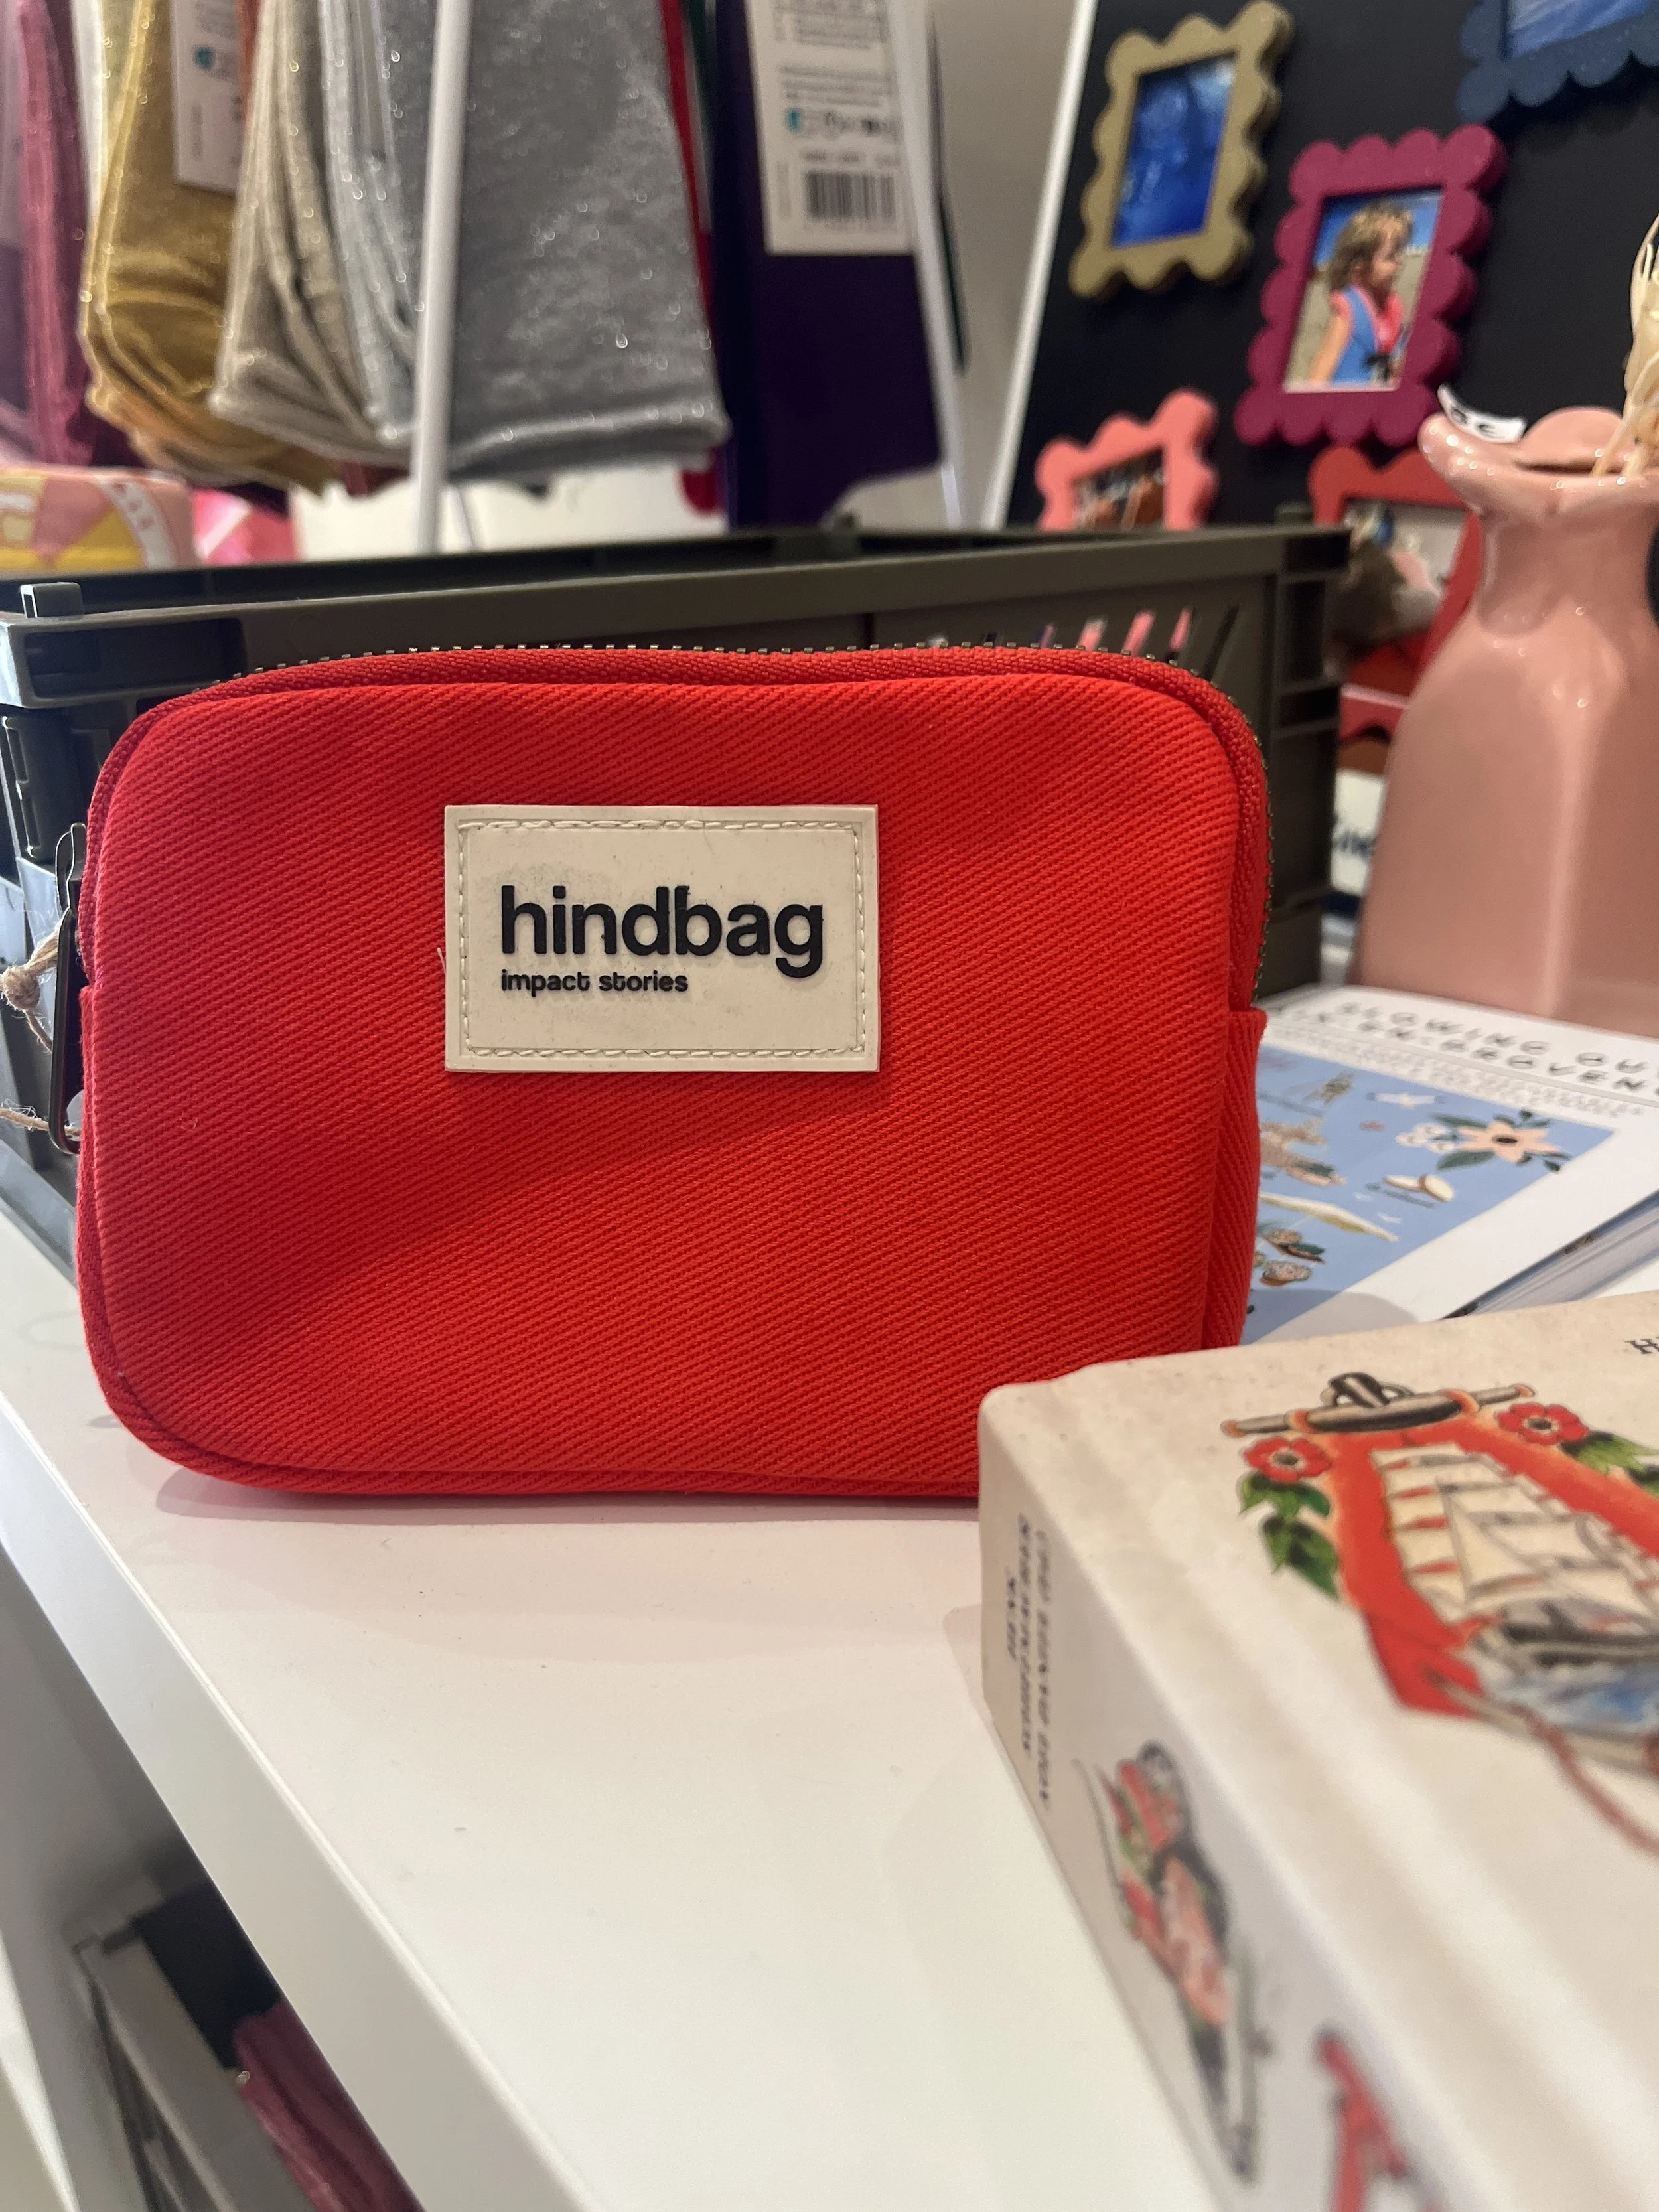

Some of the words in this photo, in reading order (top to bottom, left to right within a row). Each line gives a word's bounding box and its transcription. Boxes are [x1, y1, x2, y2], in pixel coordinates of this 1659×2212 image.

[501, 885, 824, 979] hindbag
[501, 969, 591, 998] impact
[599, 970, 689, 992] stories
